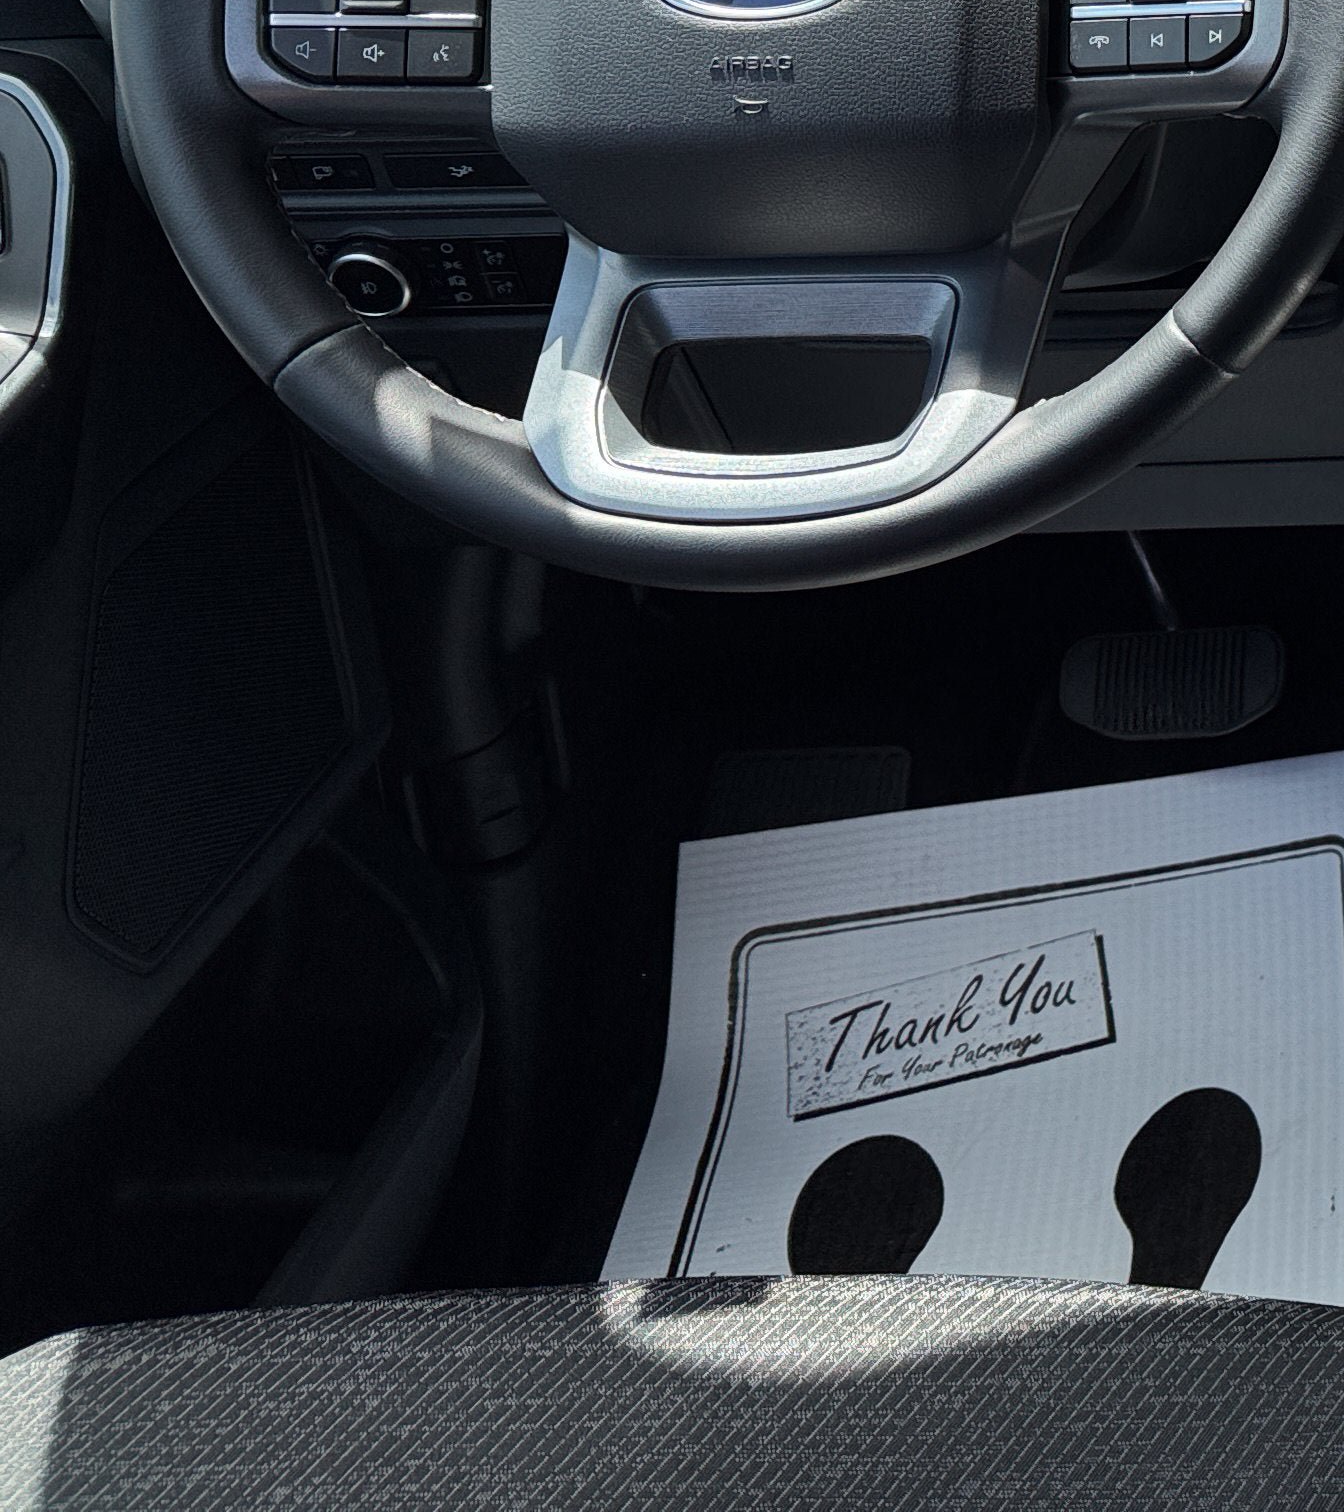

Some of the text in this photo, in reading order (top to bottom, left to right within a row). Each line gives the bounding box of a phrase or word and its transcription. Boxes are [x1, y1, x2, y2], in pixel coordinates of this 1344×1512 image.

[709, 55, 795, 73] AIRBAG
[824, 953, 1077, 1073] Thank You
[857, 1032, 1043, 1091] For Your Patronage
